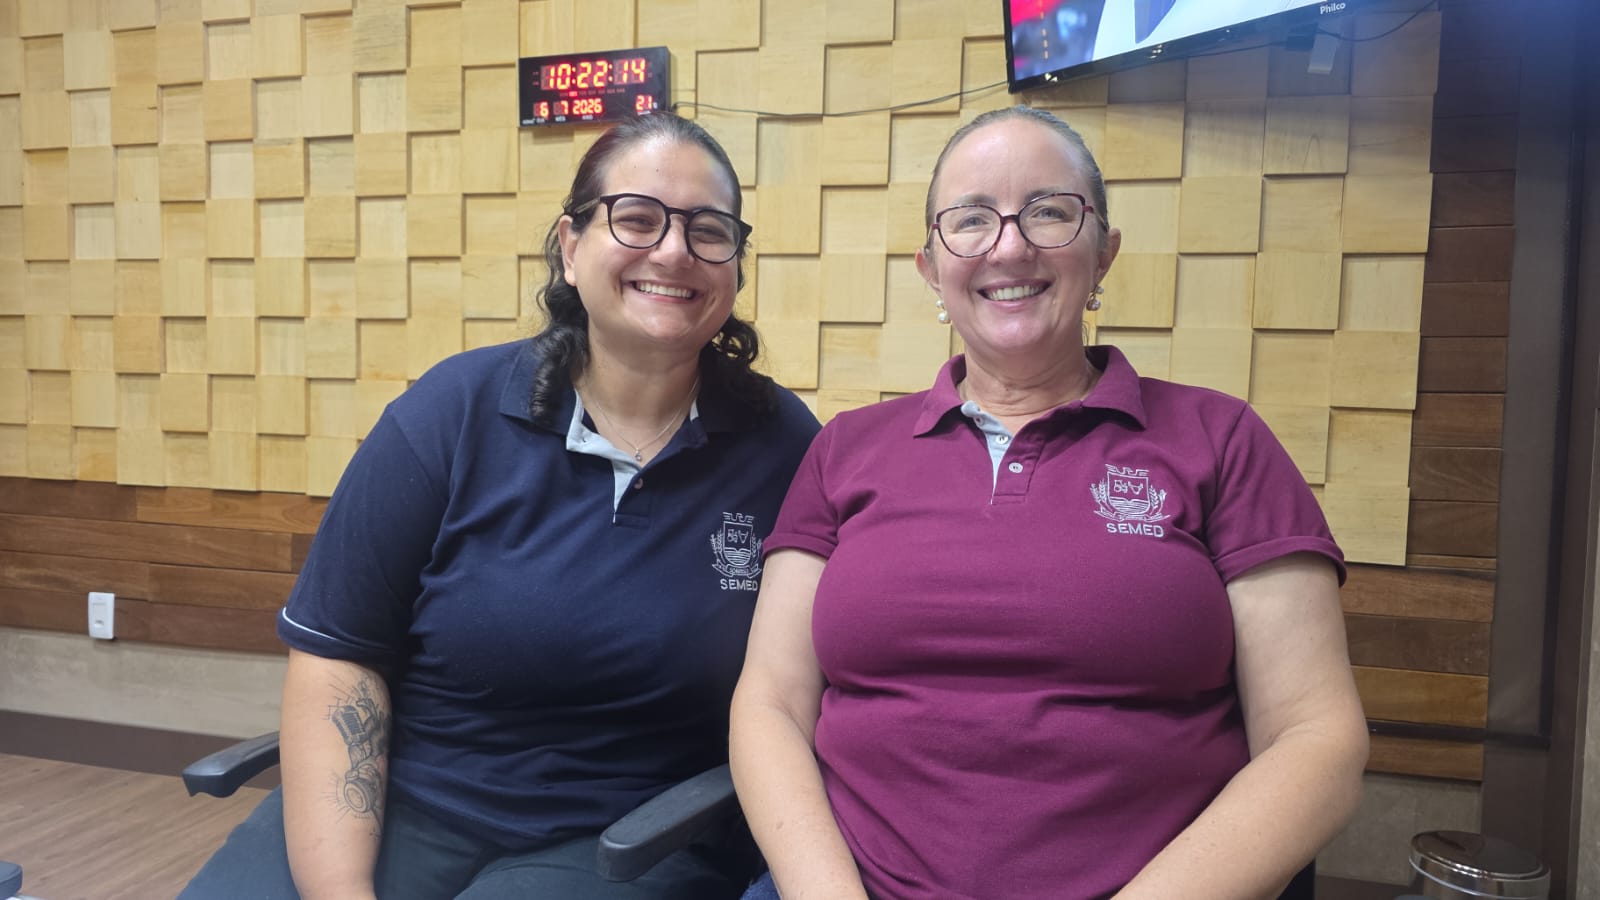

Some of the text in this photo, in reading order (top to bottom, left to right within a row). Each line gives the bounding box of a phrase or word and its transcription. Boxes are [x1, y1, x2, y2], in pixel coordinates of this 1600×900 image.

[1320, 2, 1346, 15] Philco
[549, 58, 646, 90] 10:22:14
[539, 98, 603, 117] 6 7 2026
[1106, 522, 1164, 538] SEMED
[720, 578, 758, 591] SEMED
